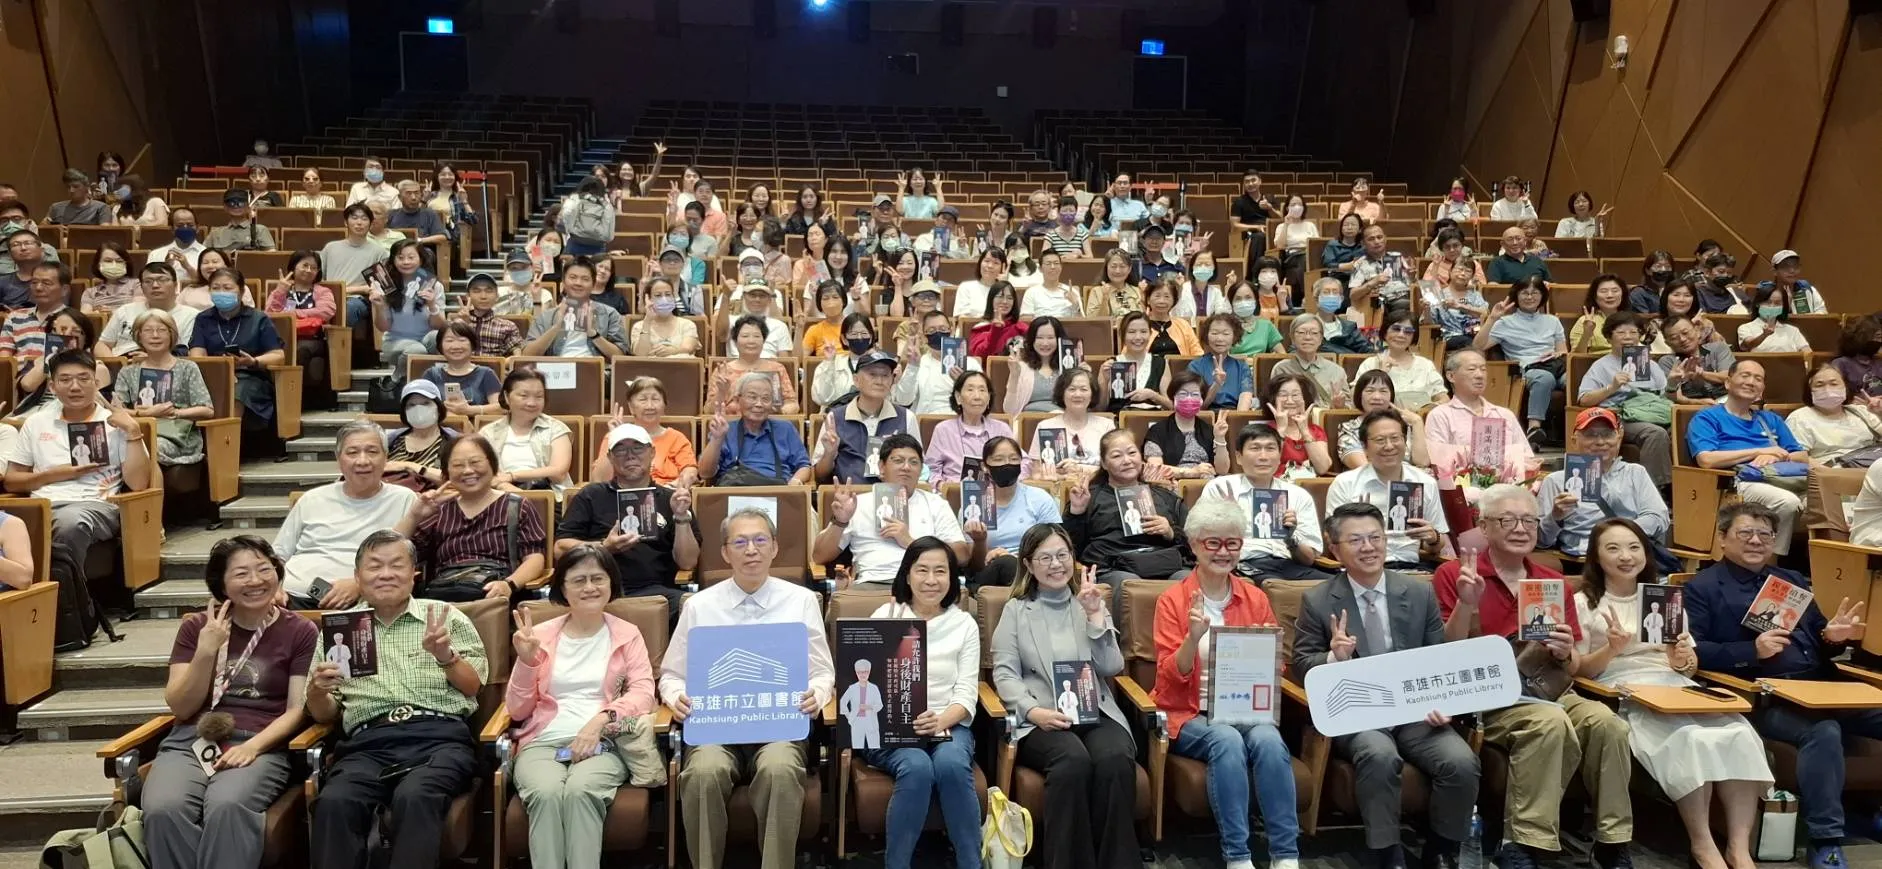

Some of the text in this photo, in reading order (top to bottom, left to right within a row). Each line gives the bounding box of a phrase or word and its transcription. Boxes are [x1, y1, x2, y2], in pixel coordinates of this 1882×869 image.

[1691, 489, 1697, 500] 3
[1836, 567, 1843, 580] 2
[31, 608, 38, 624] 2
[1401, 664, 1502, 695] 高雄市立圖書館
[900, 657, 912, 724] 身後財產自主
[1405, 682, 1504, 704] Kaohsiung Public Library
[690, 691, 804, 711] 高雄市立圖書館
[689, 710, 805, 724] Kaohsiung Public Library
